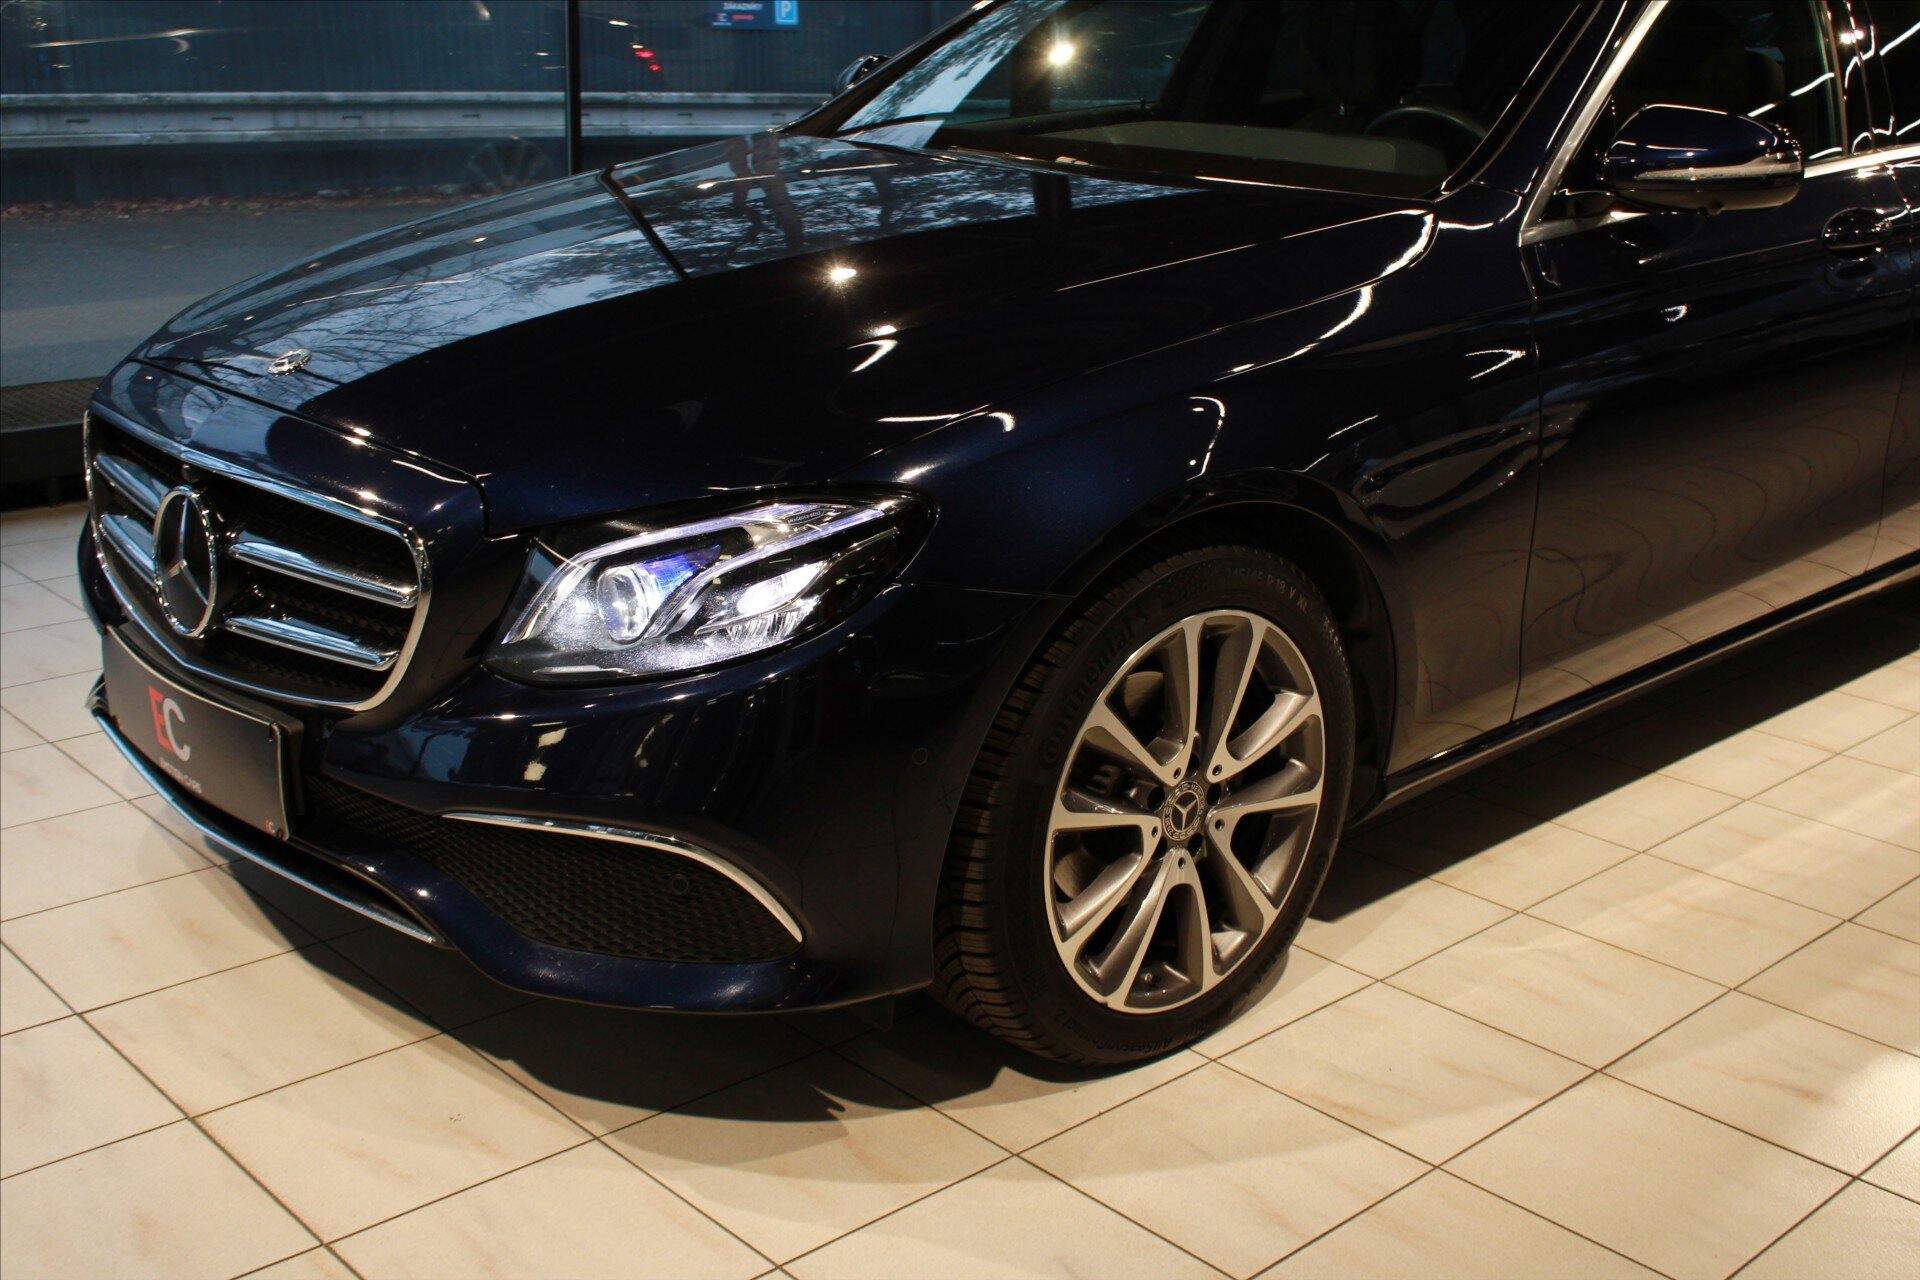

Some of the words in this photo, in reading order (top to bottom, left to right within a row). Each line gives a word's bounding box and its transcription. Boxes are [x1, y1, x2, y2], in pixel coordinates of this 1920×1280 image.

[781, 0, 792, 18] P
[148, 685, 190, 762] EC
[1038, 615, 1134, 770] Continental
